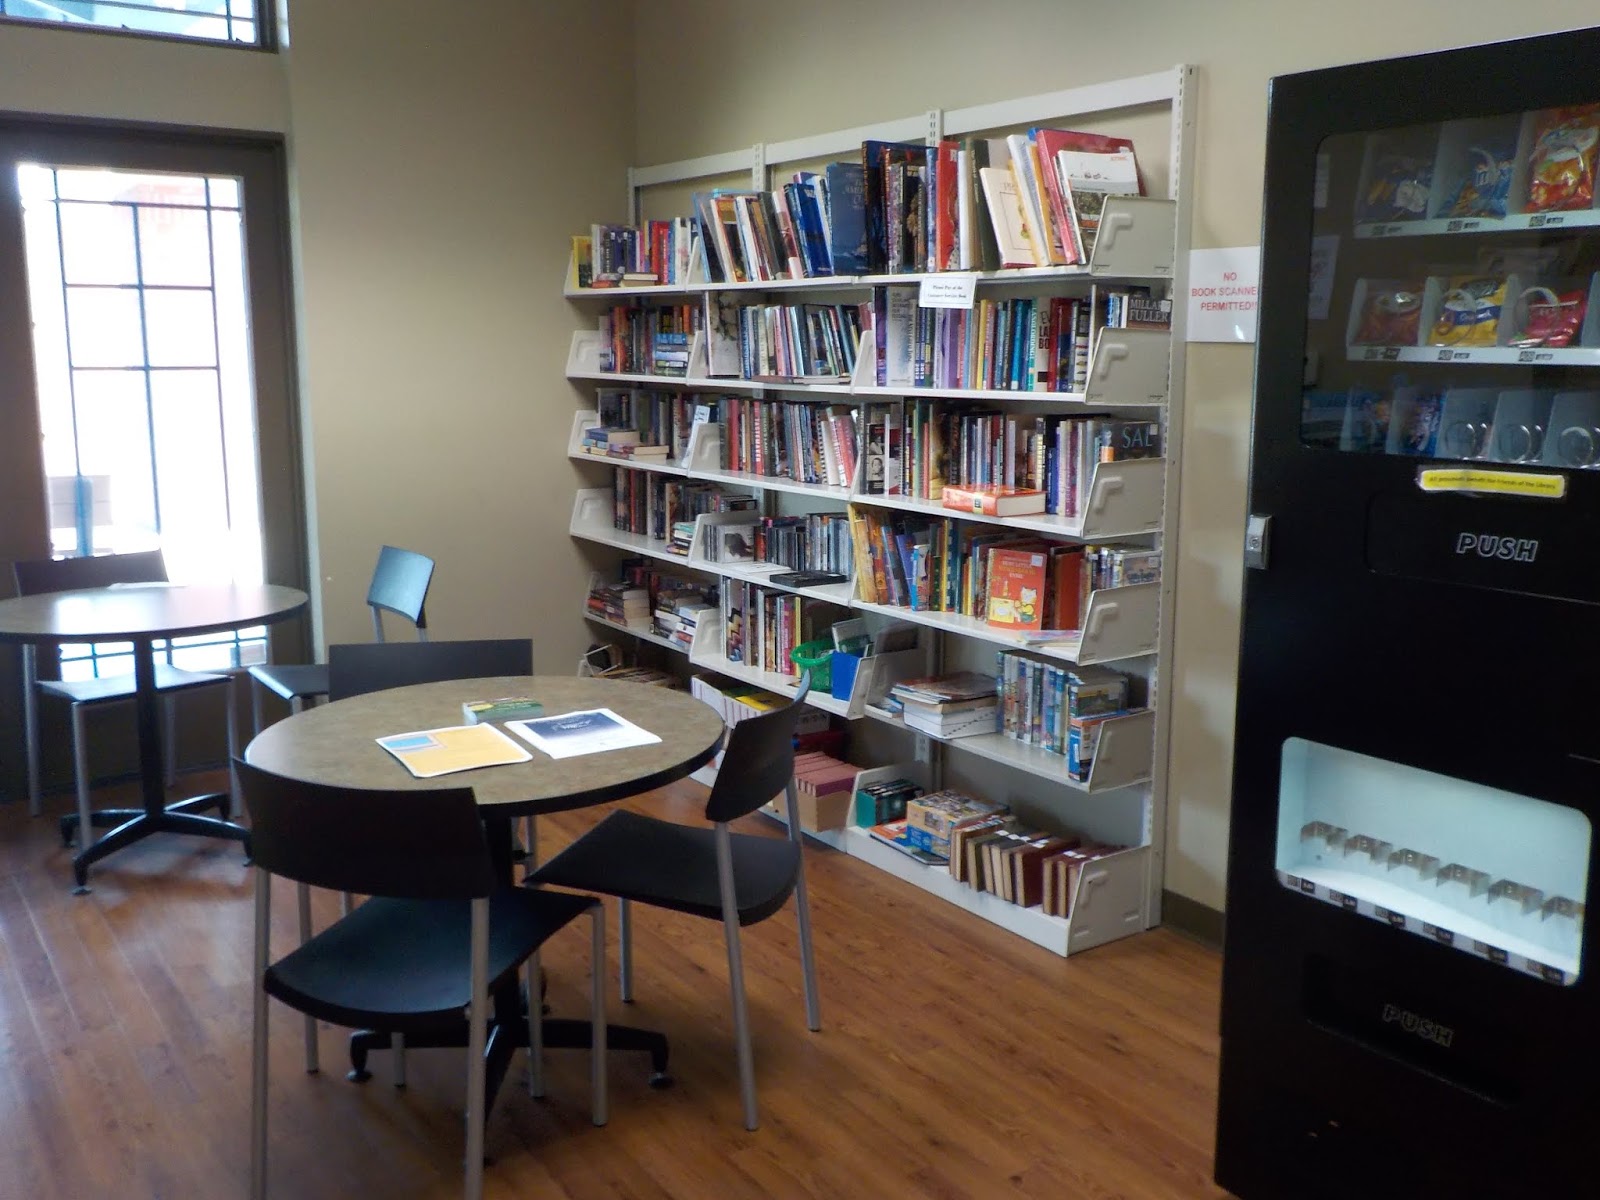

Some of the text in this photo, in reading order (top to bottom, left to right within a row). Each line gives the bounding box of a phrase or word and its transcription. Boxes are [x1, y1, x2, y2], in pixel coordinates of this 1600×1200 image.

[1223, 272, 1238, 282] NO
[1191, 287, 1258, 297] BOOK SCANNE
[1130, 299, 1163, 310] MILLA
[1129, 309, 1168, 322] FULLER
[1456, 532, 1538, 562] PUSH
[1382, 1003, 1454, 1047] PUSH
